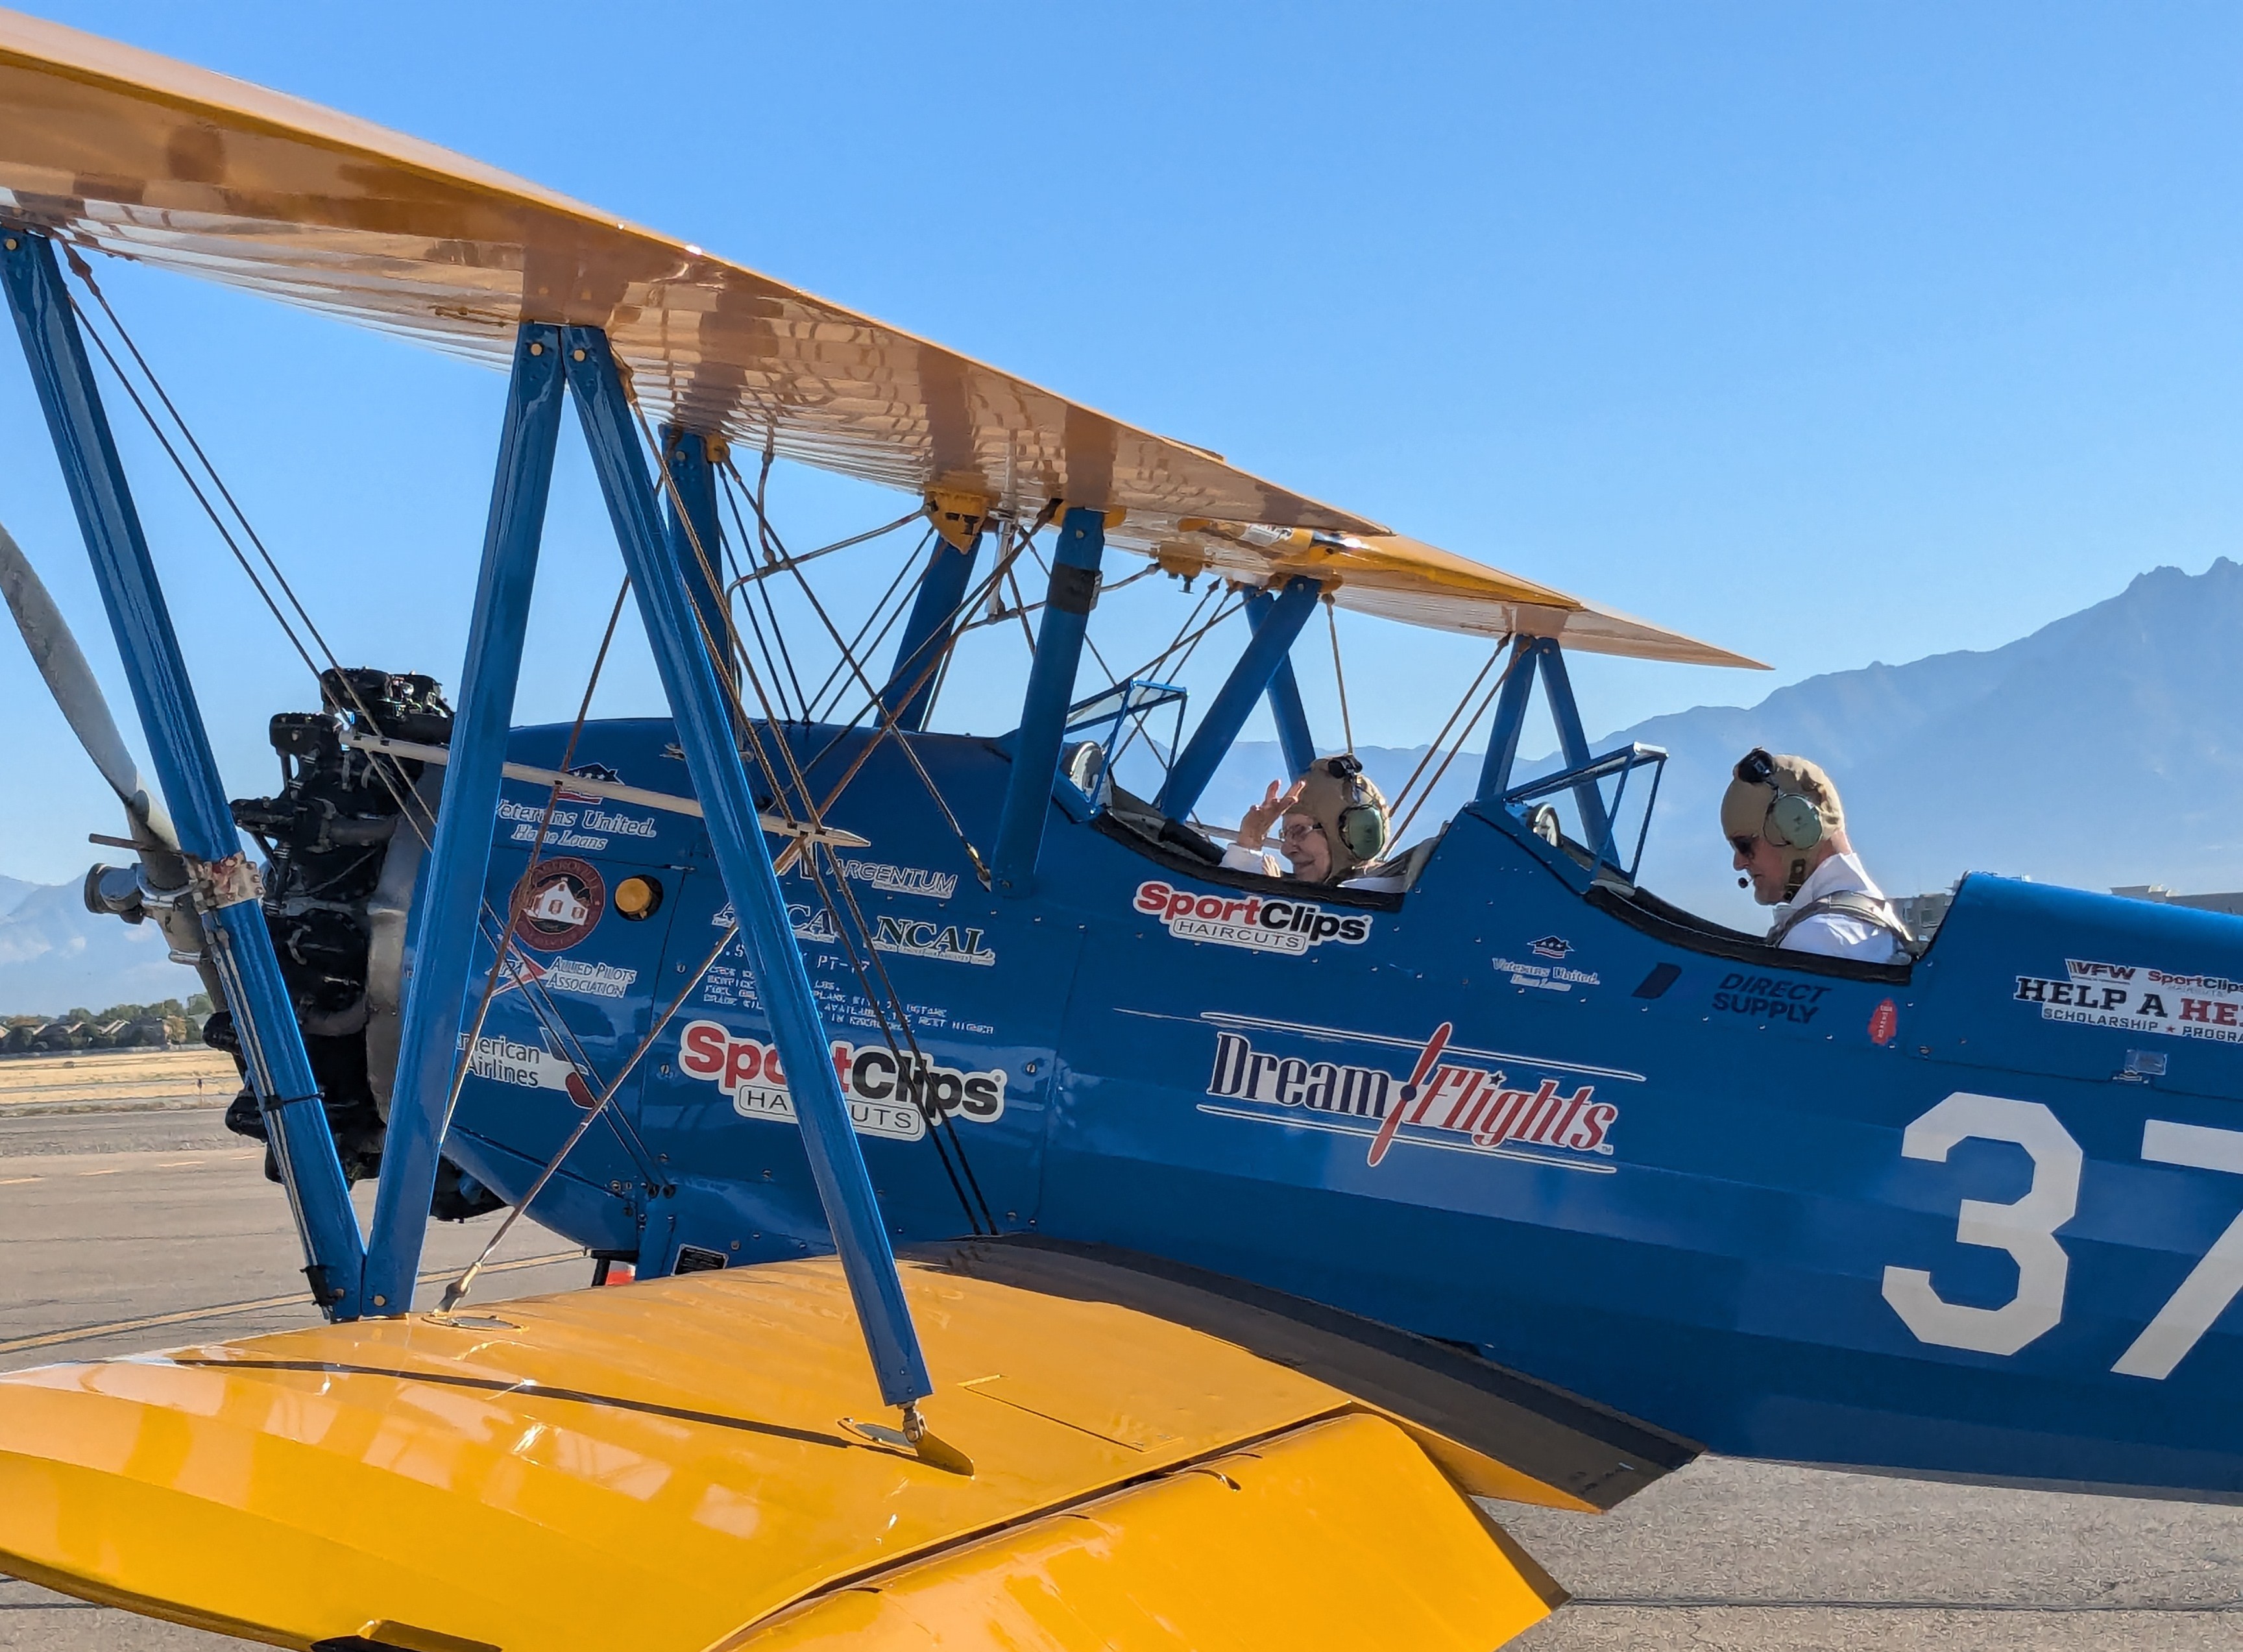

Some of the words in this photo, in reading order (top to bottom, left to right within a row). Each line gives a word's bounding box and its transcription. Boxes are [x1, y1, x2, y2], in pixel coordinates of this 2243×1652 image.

[557, 830, 609, 851] Loans
[1137, 883, 1365, 941] SportClips
[872, 915, 995, 959] NCAL
[1178, 921, 1300, 948] HAIRCUTS
[548, 974, 625, 997] ASSOCIATION
[552, 958, 592, 976] ALLIED
[595, 964, 636, 983] PILOTS
[2077, 962, 2136, 980] VFW
[1719, 973, 1833, 1003] DIRECT
[2015, 977, 2127, 1011] HELP
[2136, 993, 2168, 1018] A
[2179, 997, 2243, 1027] HE
[1712, 992, 1819, 1024] SUPPLY
[2044, 1008, 2159, 1031] SCHOLARSHIP
[468, 1055, 539, 1087] Airlines
[684, 1026, 998, 1118] SpotClips
[1208, 1032, 1390, 1119] Dream
[1411, 1065, 1618, 1151] Flights
[746, 1089, 912, 1129] HAUTS
